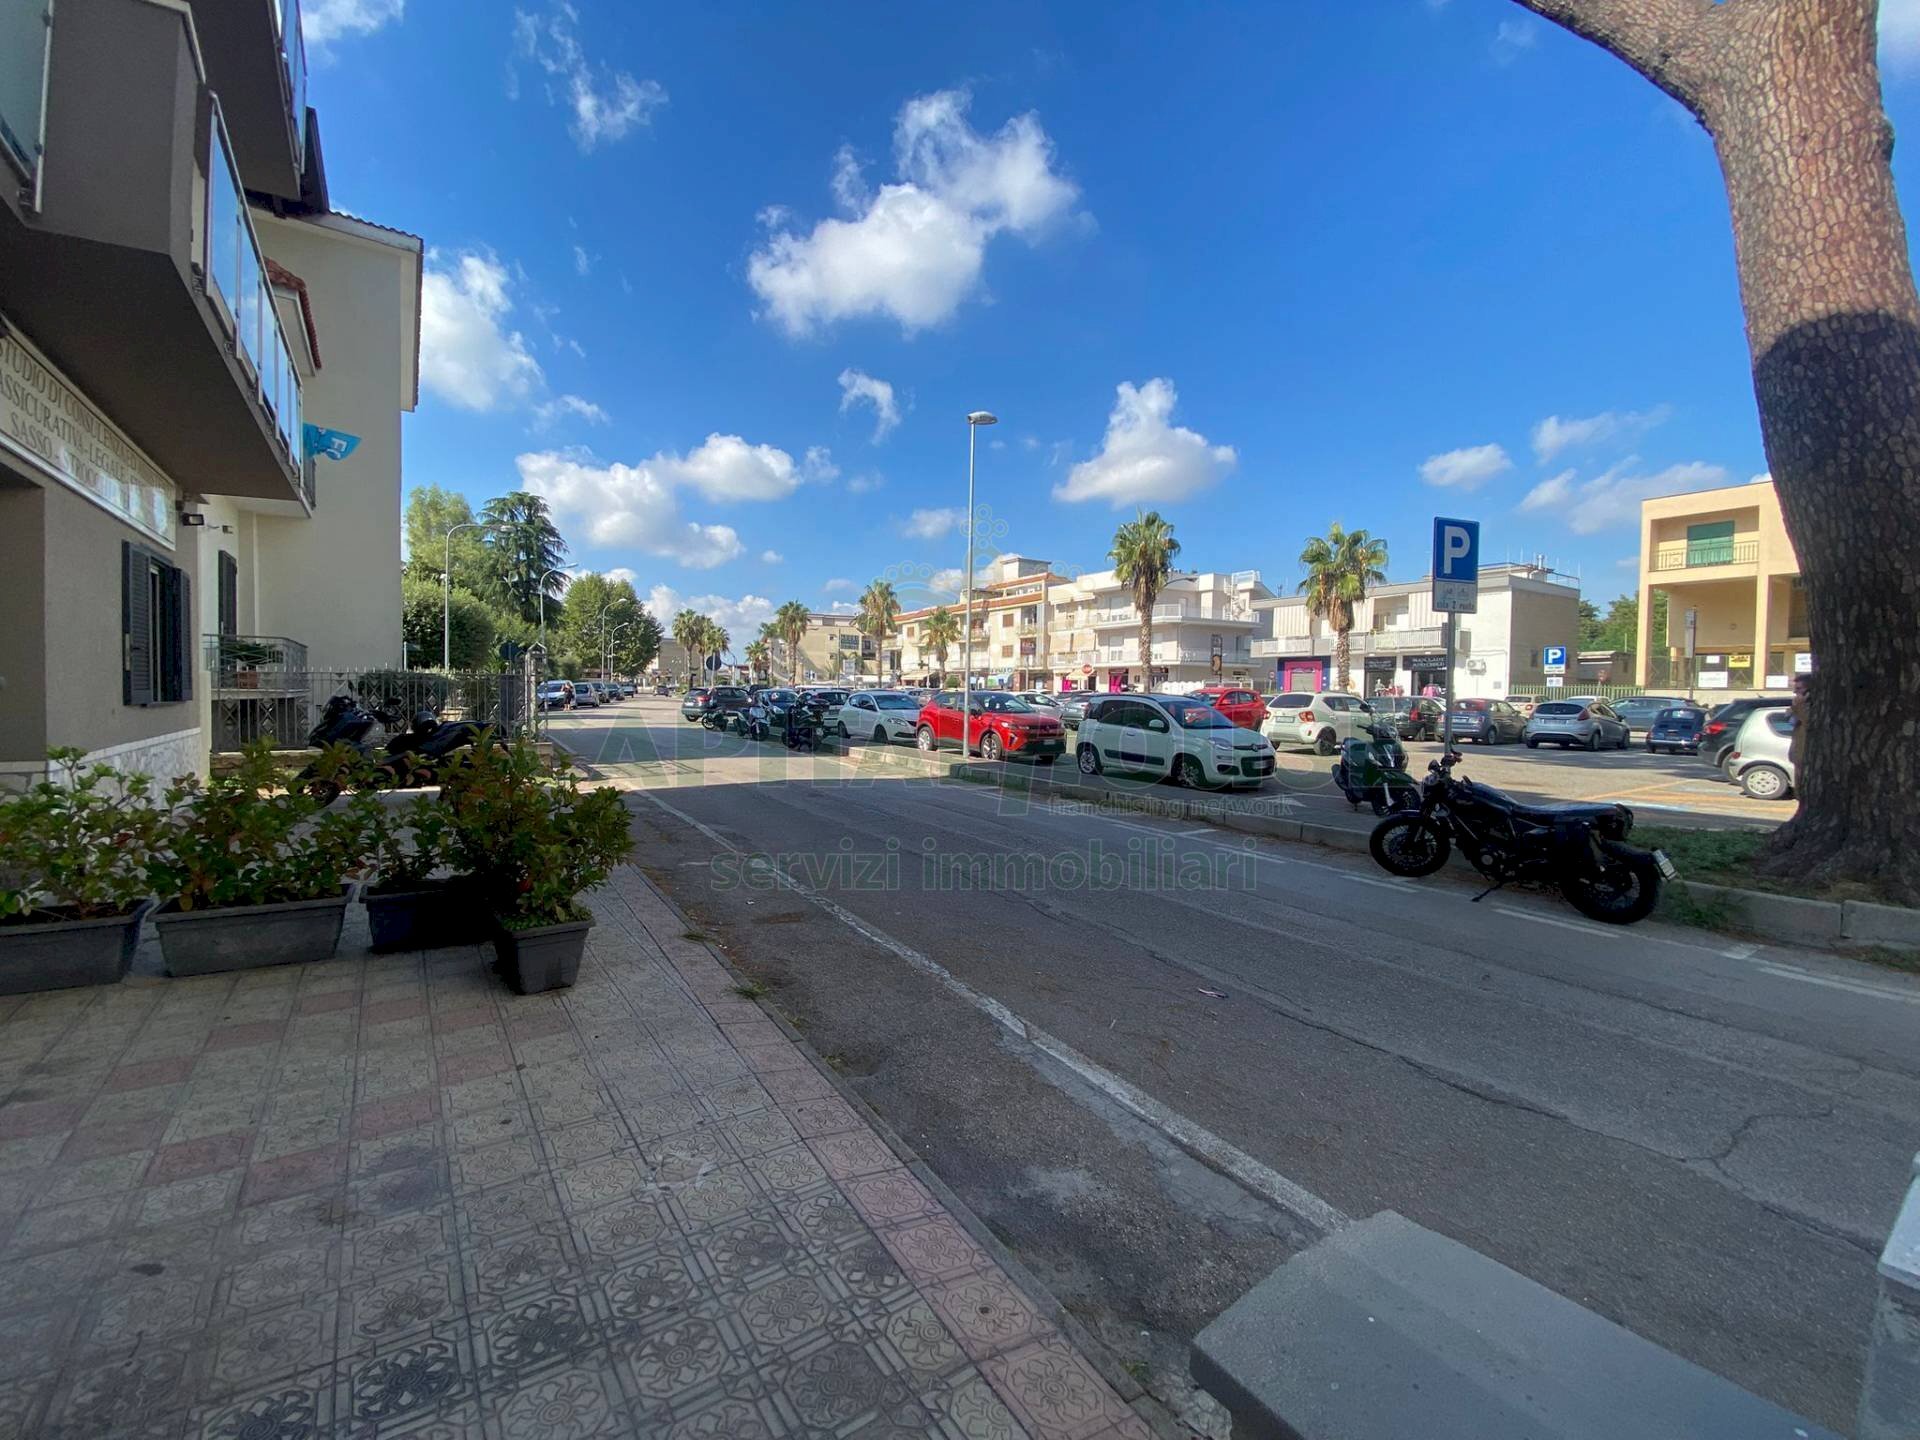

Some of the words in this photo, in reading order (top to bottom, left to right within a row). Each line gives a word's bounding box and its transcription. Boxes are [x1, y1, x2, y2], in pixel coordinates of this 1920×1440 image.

[48, 378, 62, 409] DI
[11, 411, 52, 460] SASSO
[1444, 525, 1471, 574] P
[1548, 649, 1562, 664] P
